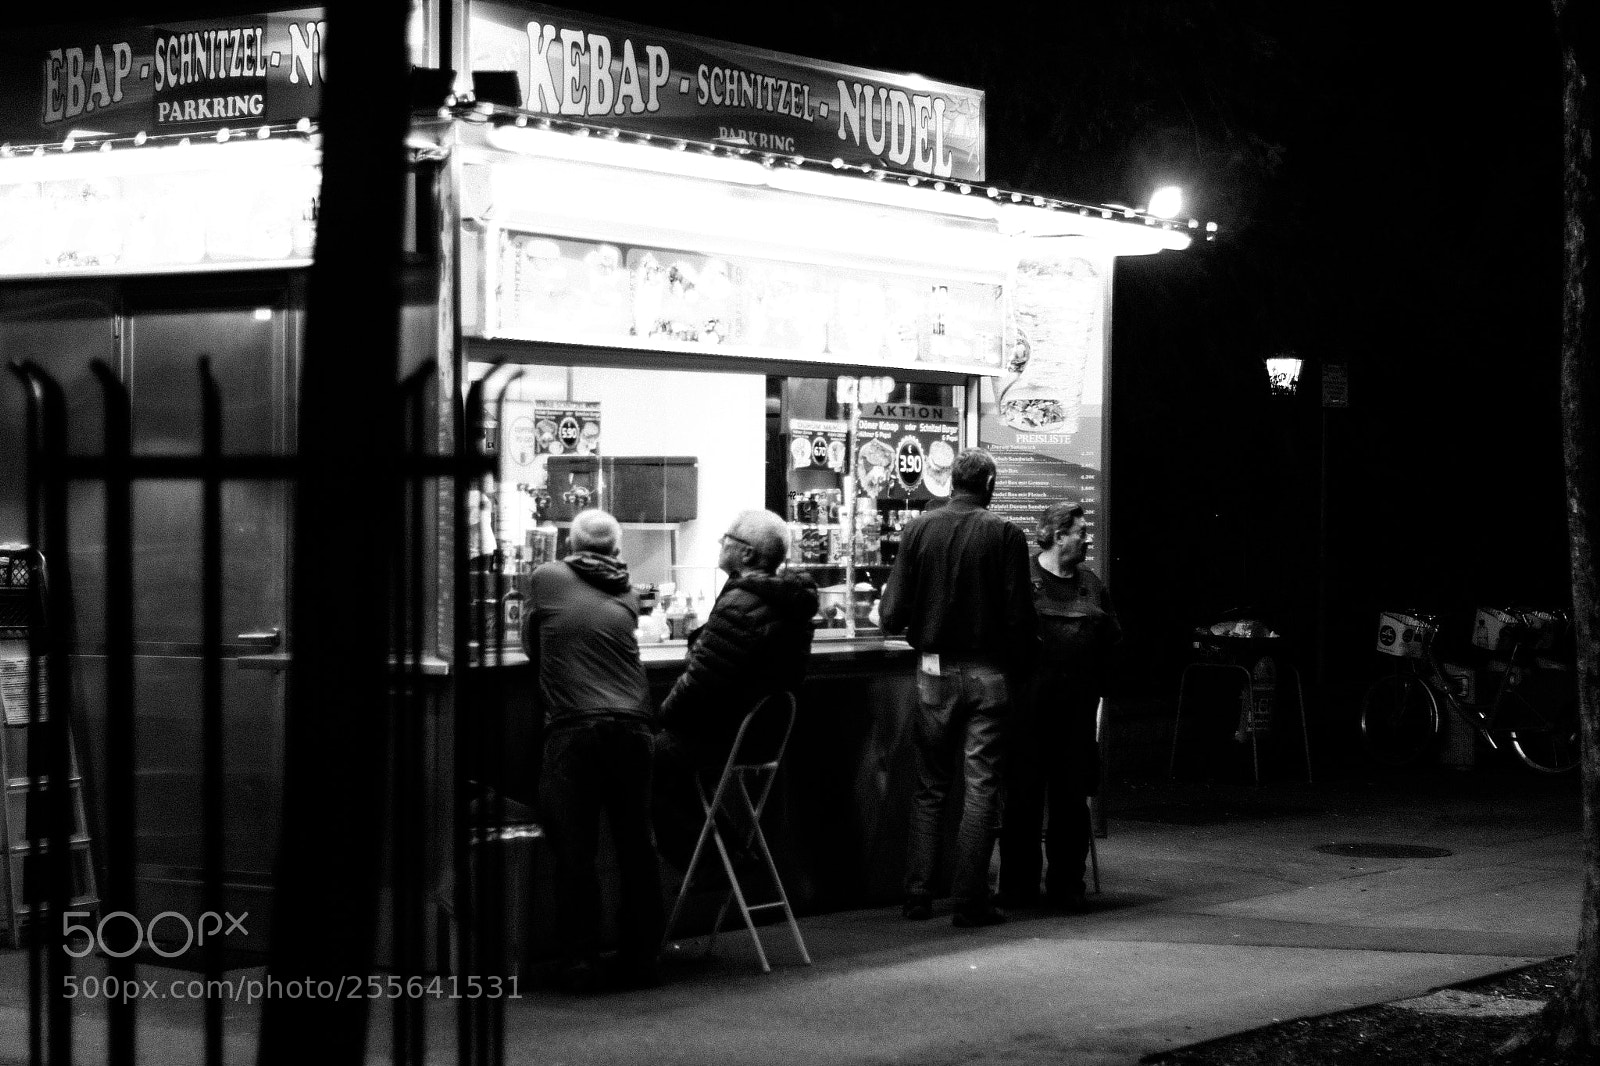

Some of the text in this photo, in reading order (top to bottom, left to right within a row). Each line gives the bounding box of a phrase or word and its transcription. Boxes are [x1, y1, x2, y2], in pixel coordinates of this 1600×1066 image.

[154, 27, 267, 92] SCHNITZEL
[158, 94, 264, 122] PARKRING
[525, 21, 669, 115] KEBAP
[697, 63, 815, 122] SCHNITZEL
[836, 80, 952, 177] NUDEL
[718, 126, 795, 153] PARKRING
[873, 404, 943, 419] AKTION
[1016, 433, 1072, 445] PREISLISTE
